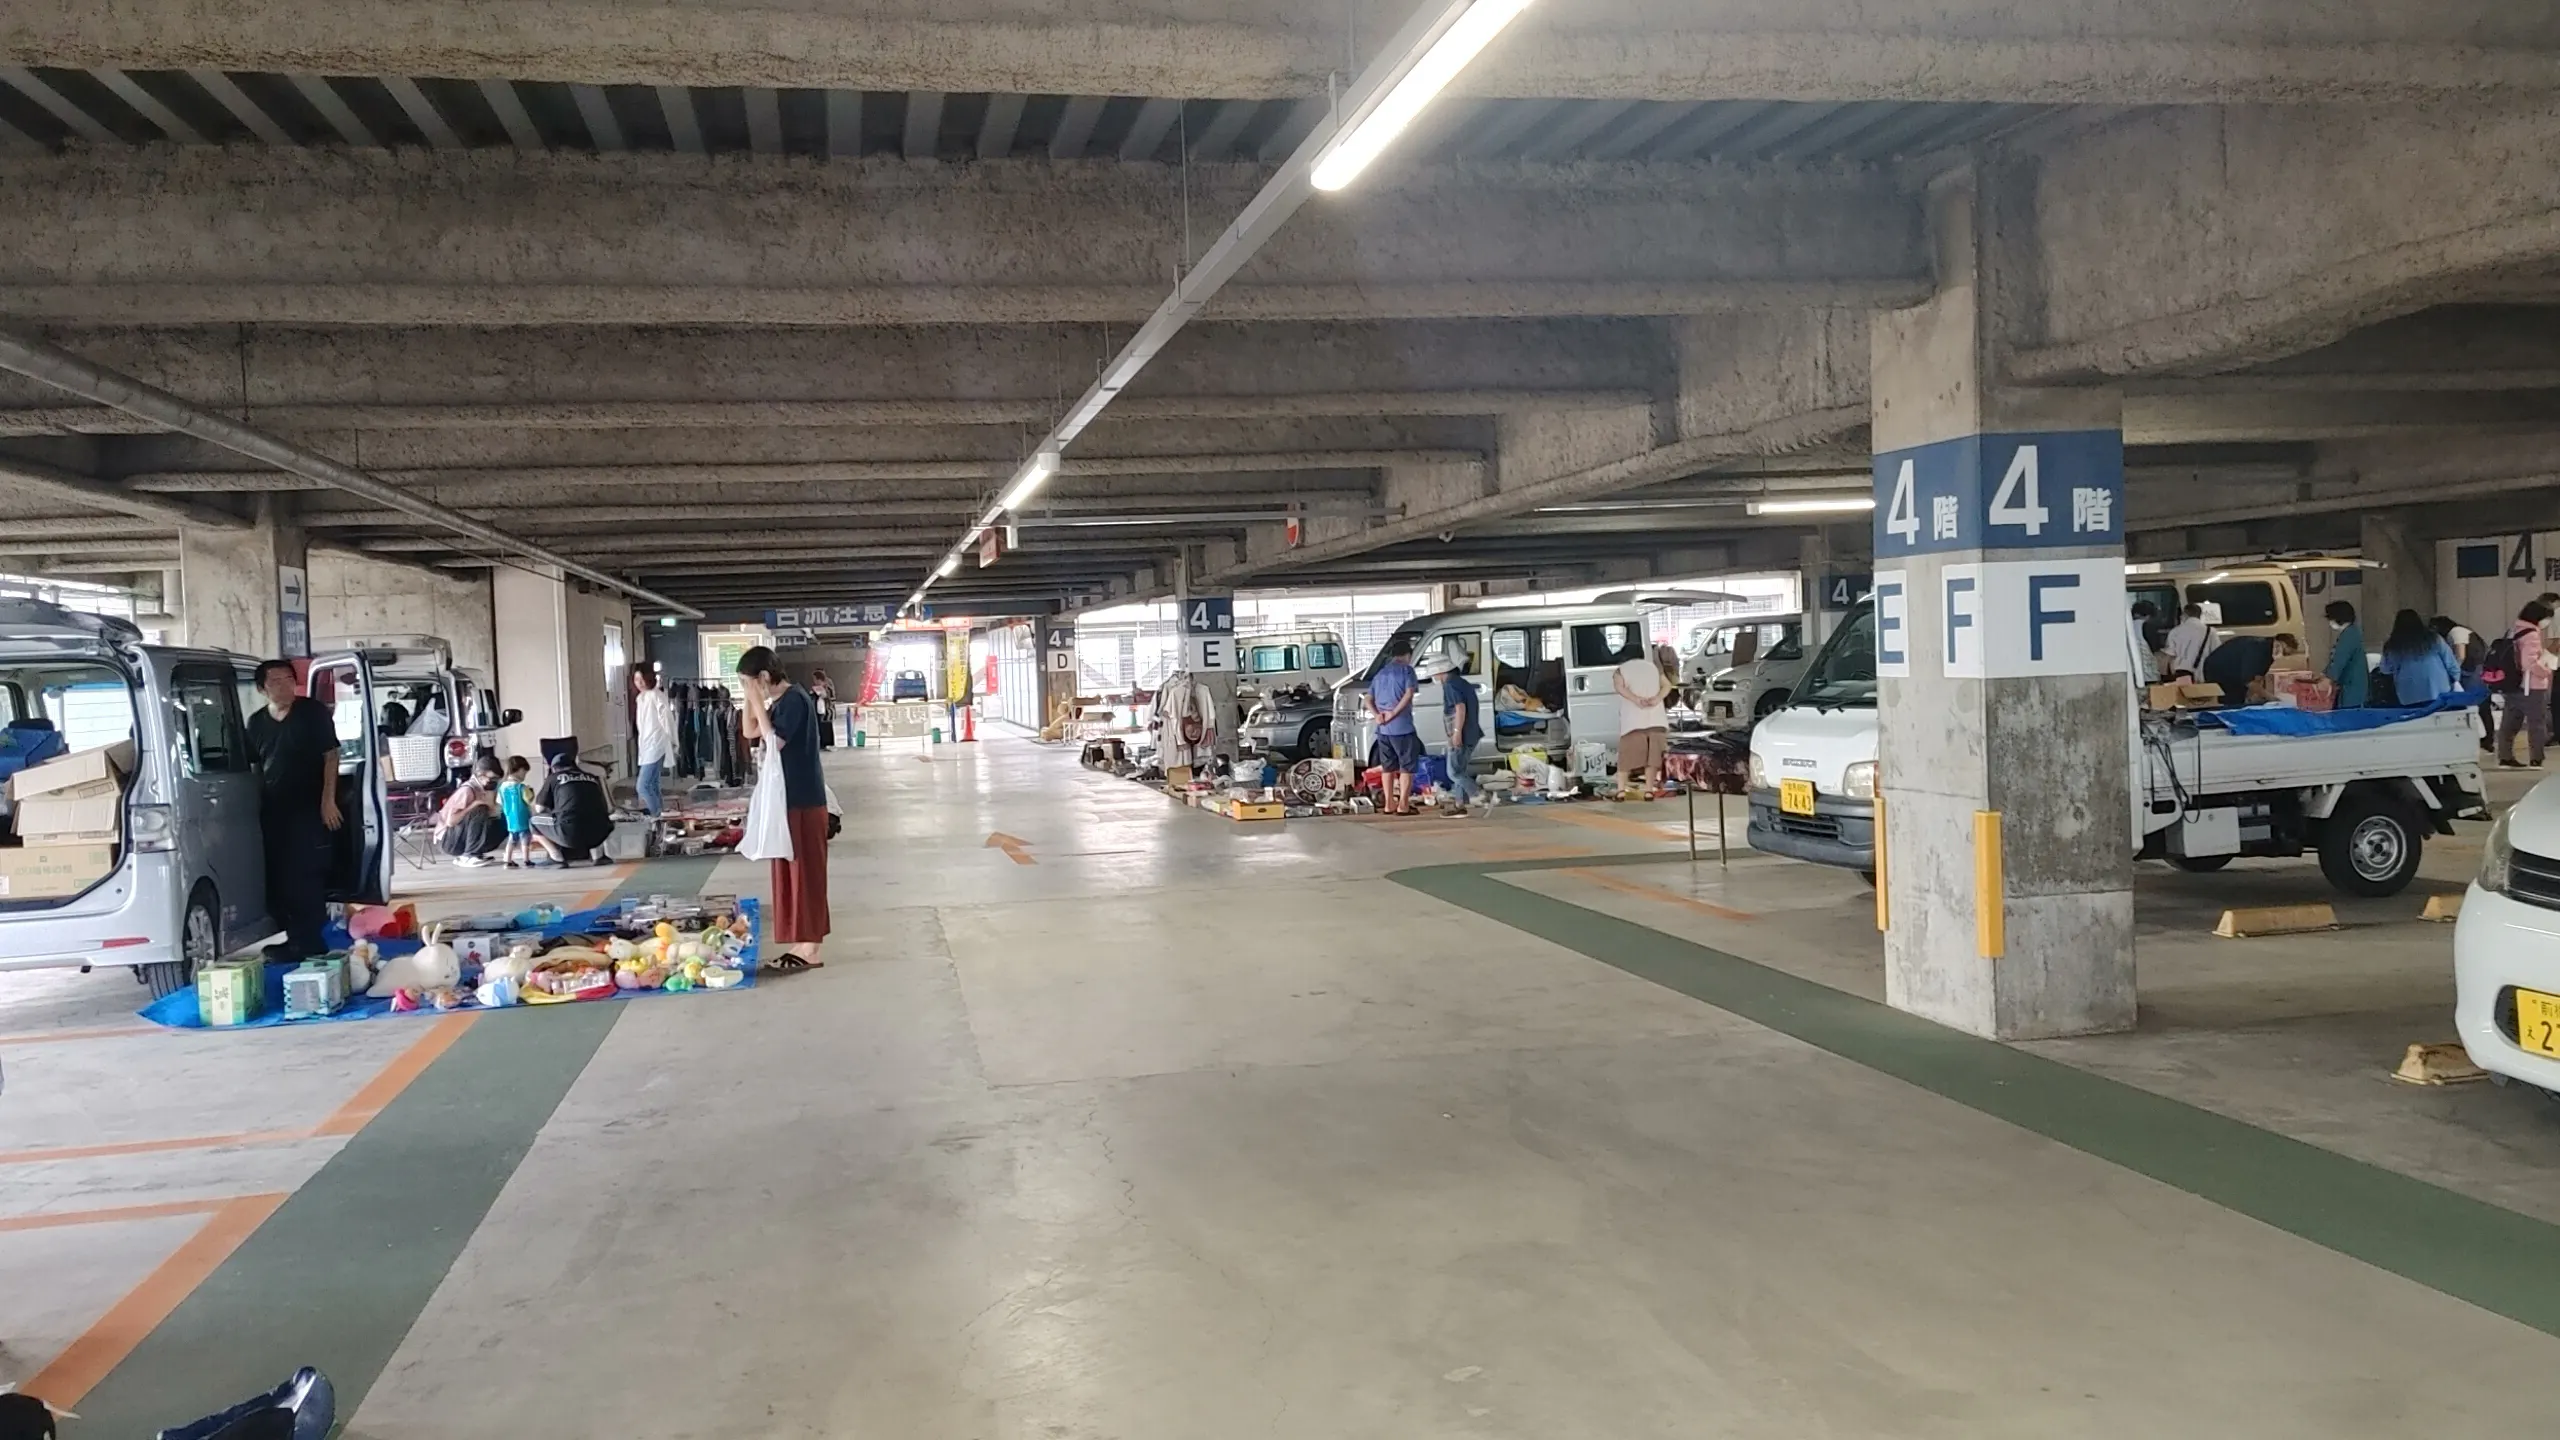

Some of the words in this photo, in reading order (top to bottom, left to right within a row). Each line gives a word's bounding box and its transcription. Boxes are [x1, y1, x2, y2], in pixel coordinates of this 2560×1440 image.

[1887, 459, 1959, 546] 4階
[1989, 445, 2113, 536] 4階
[1190, 602, 1231, 630] 4階
[1203, 641, 1221, 667] E
[1877, 583, 1905, 664] E
[1947, 577, 1975, 664] F
[2029, 574, 2080, 661] F
[1057, 653, 1068, 669] D
